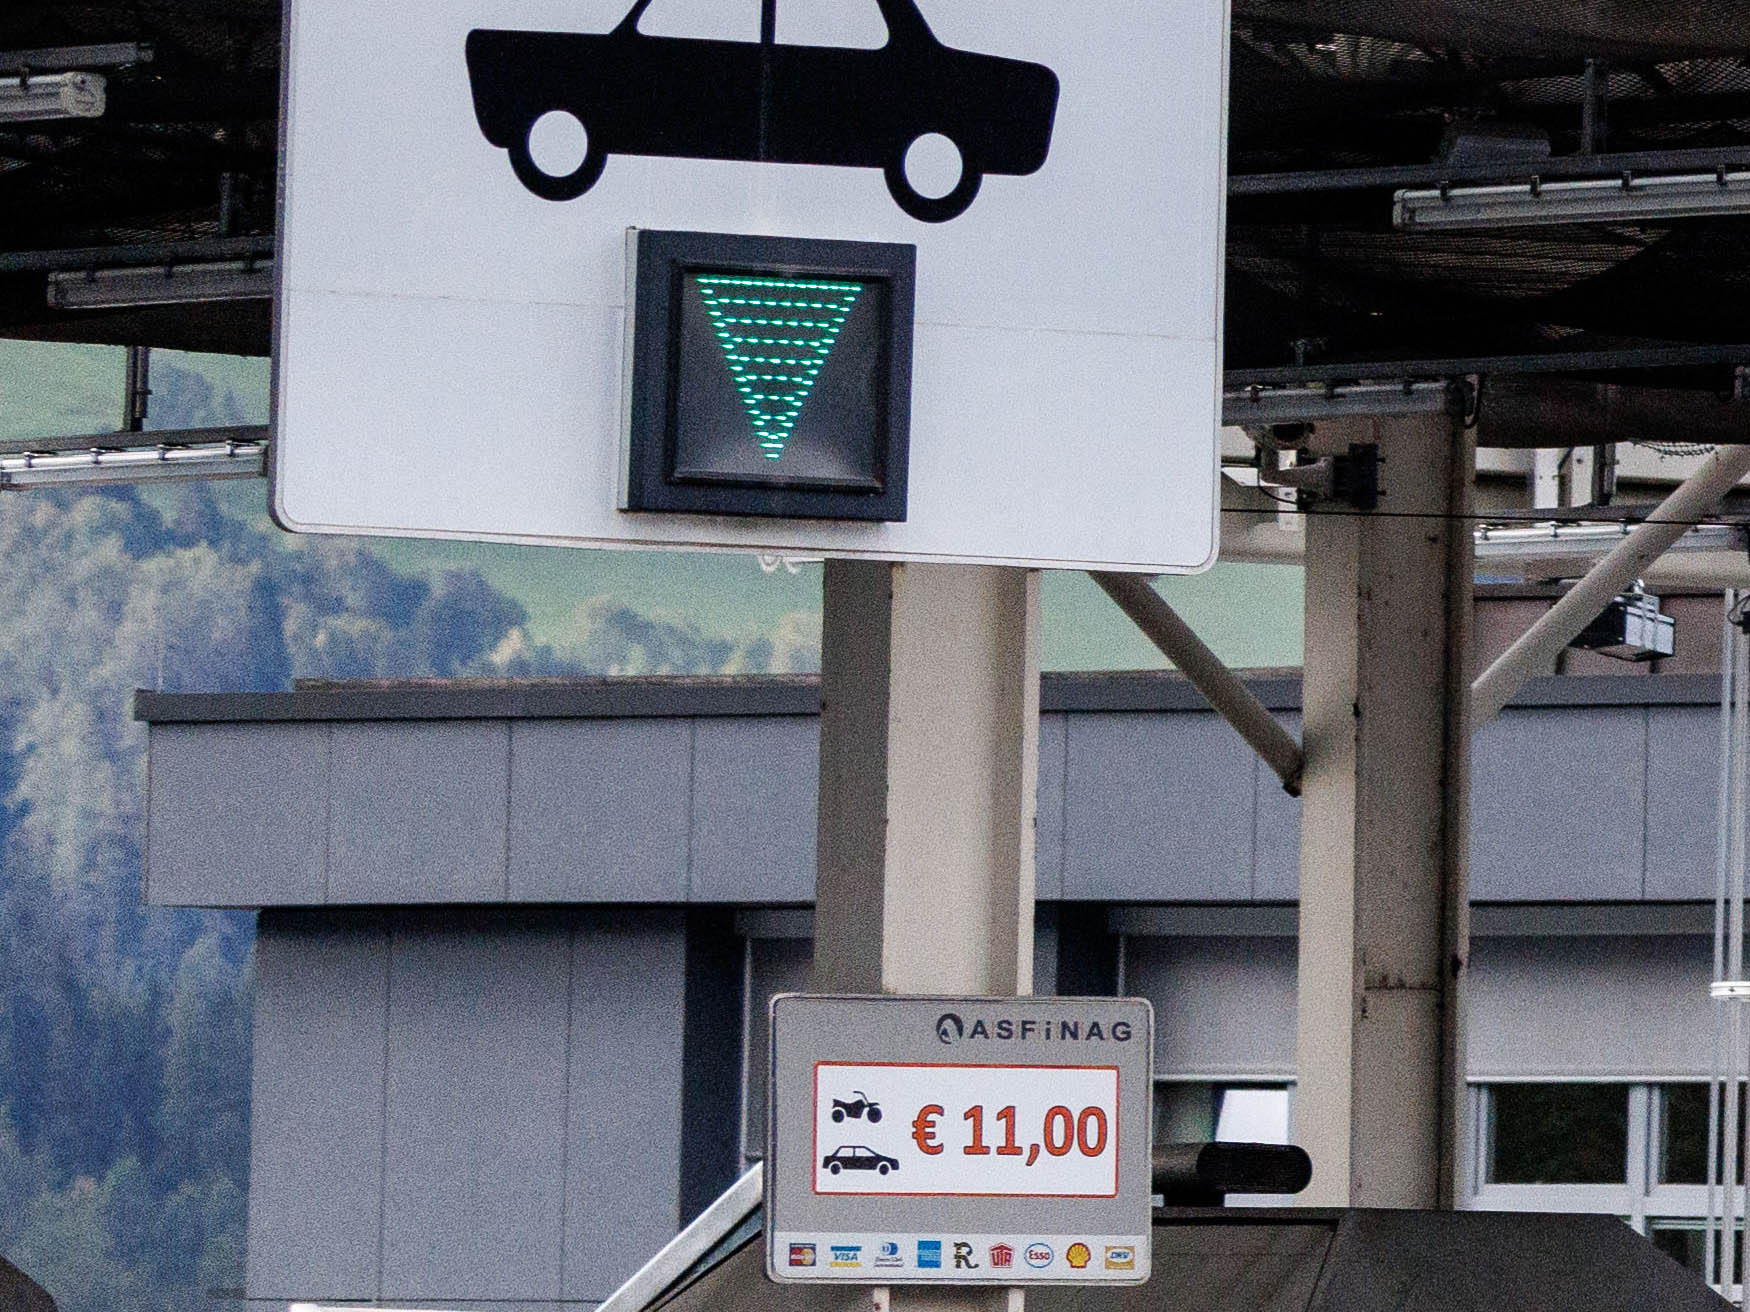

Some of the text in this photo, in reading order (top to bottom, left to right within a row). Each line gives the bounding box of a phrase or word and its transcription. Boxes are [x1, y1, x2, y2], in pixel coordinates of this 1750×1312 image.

[911, 1103, 1109, 1167] € 11,00
[833, 1252, 859, 1262] VISA
